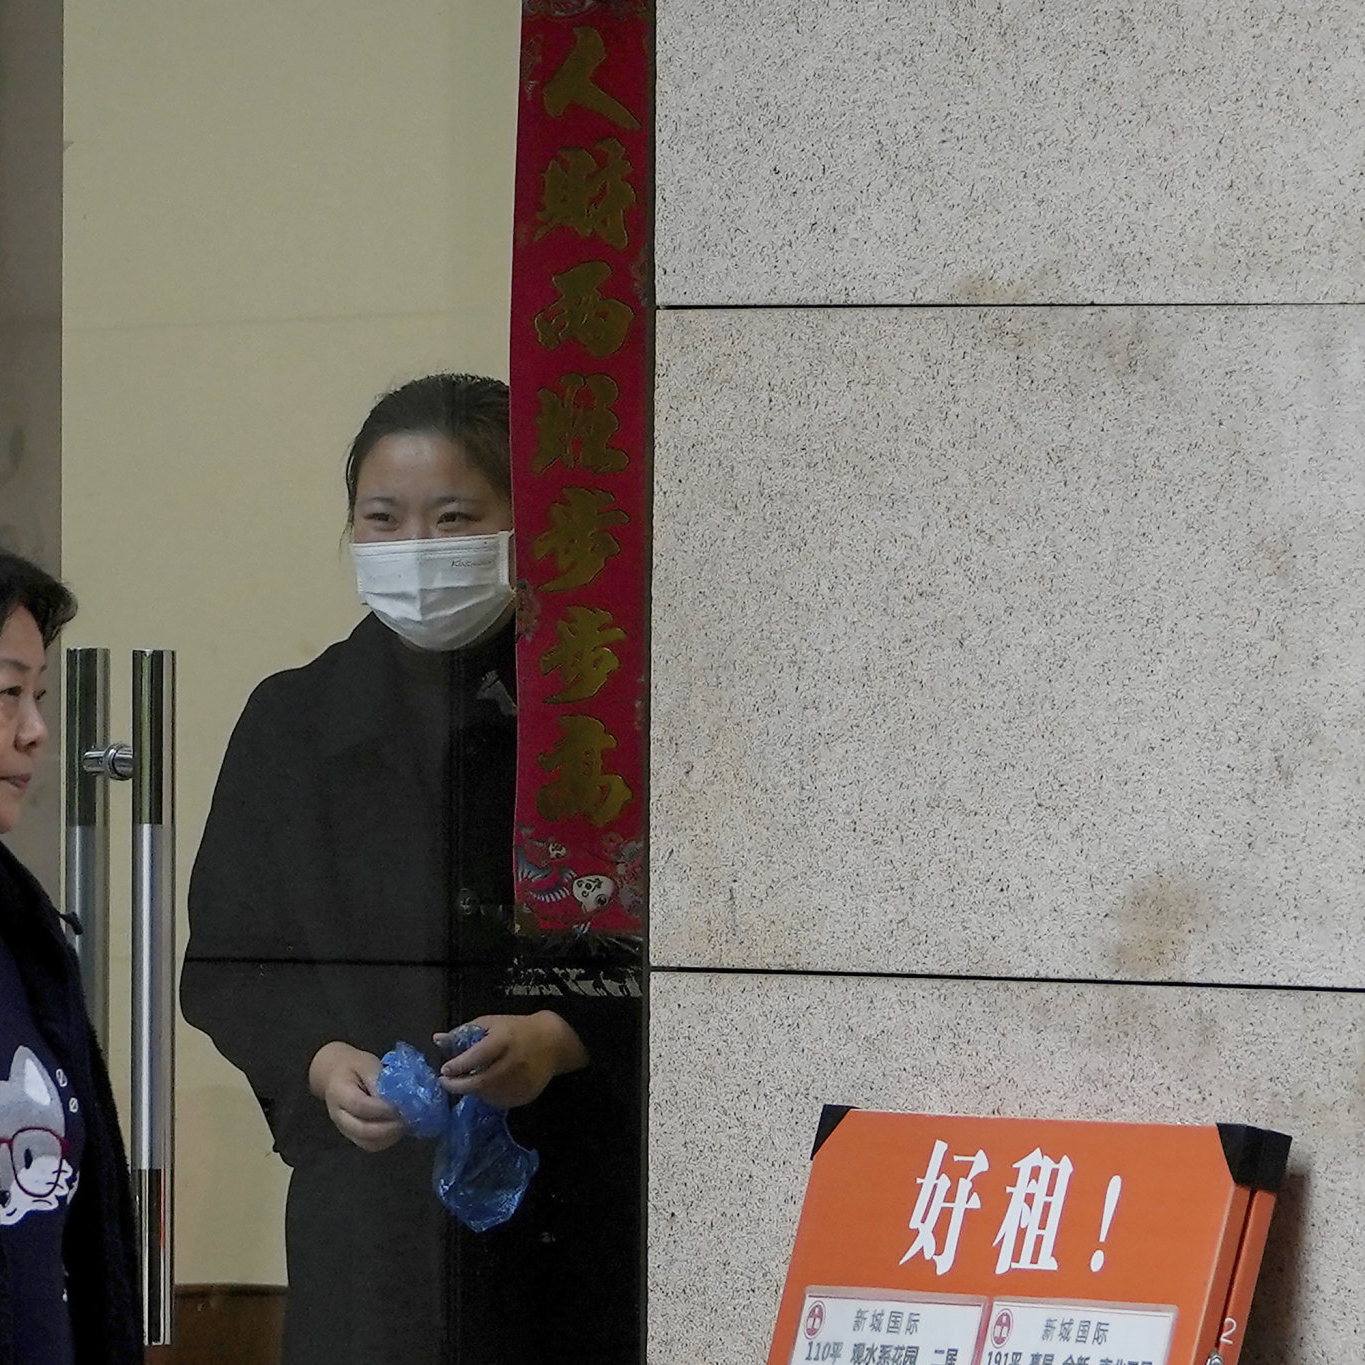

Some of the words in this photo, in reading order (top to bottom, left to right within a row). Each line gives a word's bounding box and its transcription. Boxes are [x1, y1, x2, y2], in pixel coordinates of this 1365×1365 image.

[898, 1139, 1122, 1276] 好租！
[852, 1307, 920, 1336] 新城国际
[1042, 1317, 1110, 1345] 新城国际
[1220, 1317, 1237, 1345] 2
[805, 1341, 844, 1364] 110平
